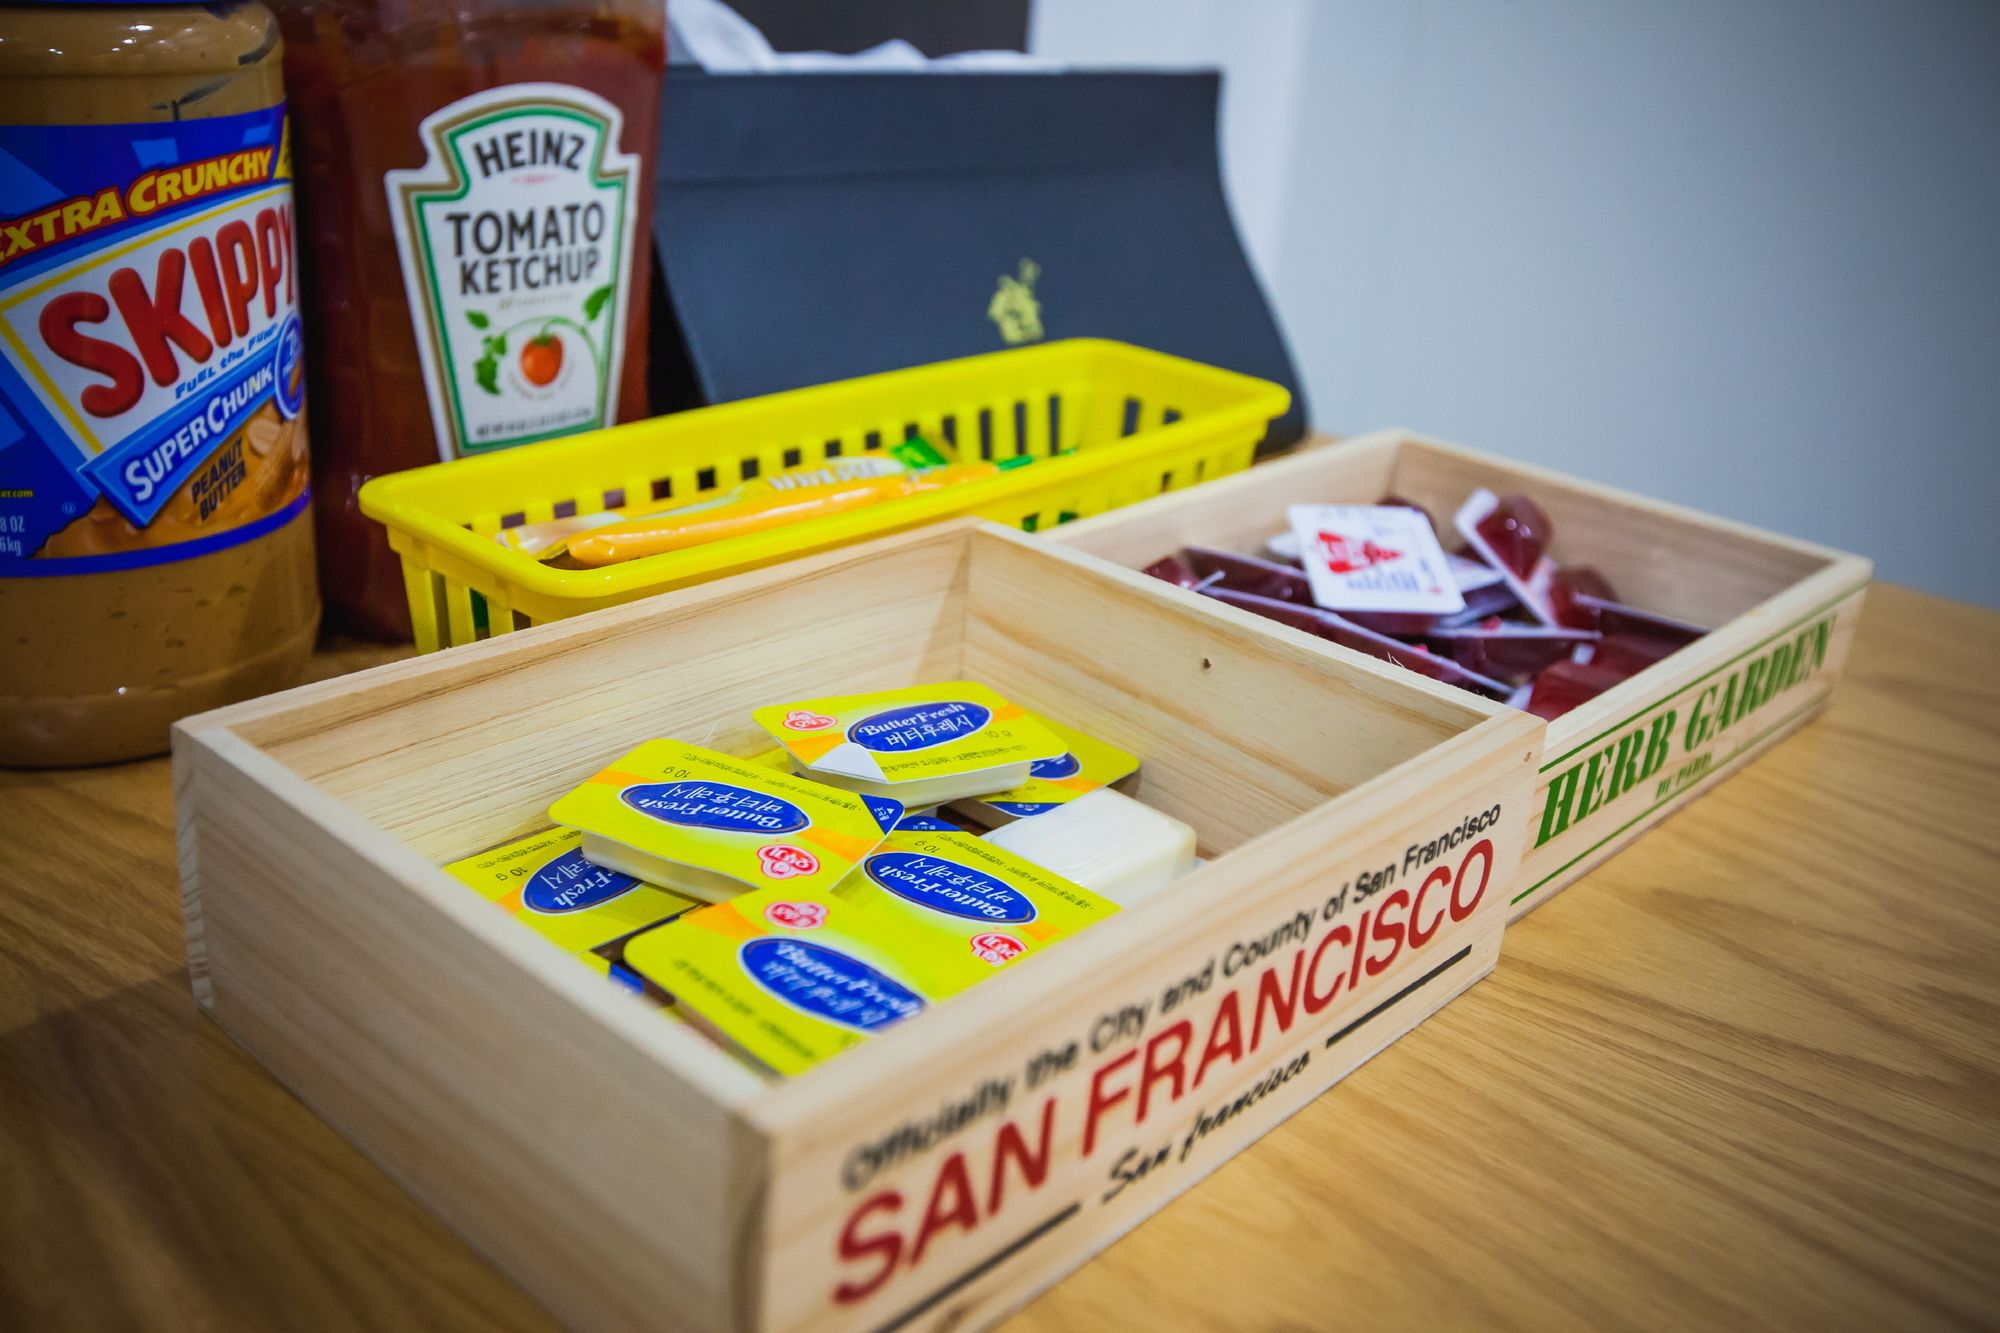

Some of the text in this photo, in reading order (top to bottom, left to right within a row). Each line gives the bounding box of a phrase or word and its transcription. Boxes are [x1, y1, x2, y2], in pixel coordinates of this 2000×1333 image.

[473, 129, 586, 178] HEINZ
[0, 150, 272, 262] XTRA CRUNCHY
[446, 201, 605, 257] TOMATO
[460, 249, 599, 295] KETCHUP
[191, 437, 243, 503] PEANUT
[199, 465, 247, 521] BUTTER
[10, 514, 25, 533] OZ
[885, 715, 974, 748] 버터후레시
[984, 729, 998, 740] 10
[1534, 612, 1837, 850] HERB GARDEN
[663, 766, 690, 779] 10 g
[661, 784, 783, 815] 버터후레시
[924, 844, 940, 854] 10
[495, 867, 528, 881] 10 g
[553, 870, 615, 907] Fresh
[904, 857, 1014, 904] 버터후레시
[1026, 1040, 1078, 1090] the
[1089, 998, 1149, 1055] City
[1160, 957, 1217, 1017] and
[1224, 906, 1317, 977] County
[1323, 882, 1350, 921] of
[1353, 862, 1397, 904] San
[1402, 803, 1501, 876] Francisco
[832, 838, 1493, 1307] SAN FRANCISCO
[1102, 1146, 1172, 1204] San
